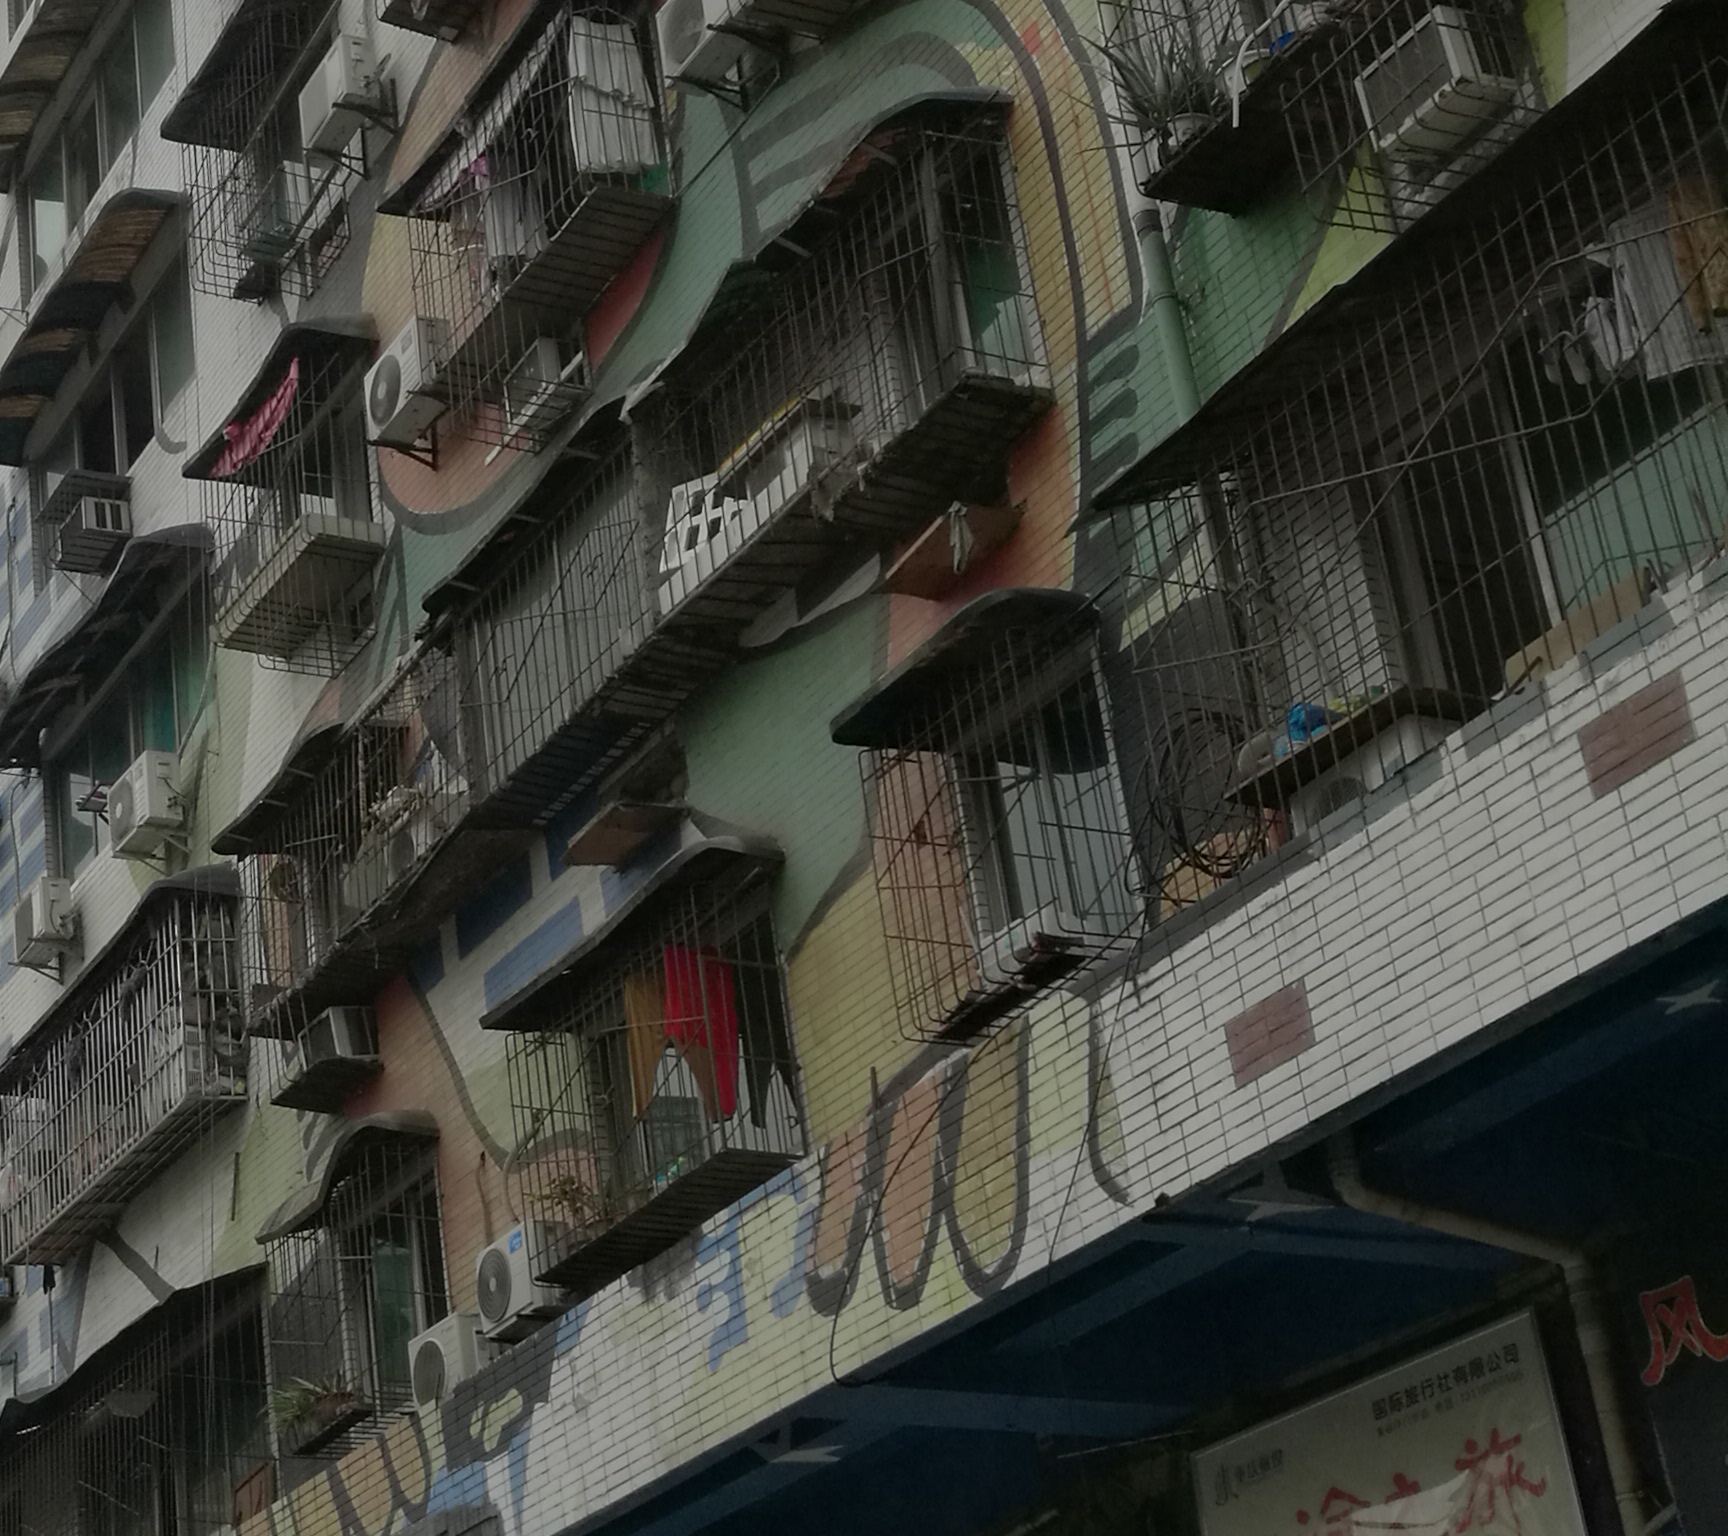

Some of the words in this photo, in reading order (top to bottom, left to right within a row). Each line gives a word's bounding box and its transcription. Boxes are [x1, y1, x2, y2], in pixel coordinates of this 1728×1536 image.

[1372, 1343, 1520, 1421] 国际旅行社有限公司
